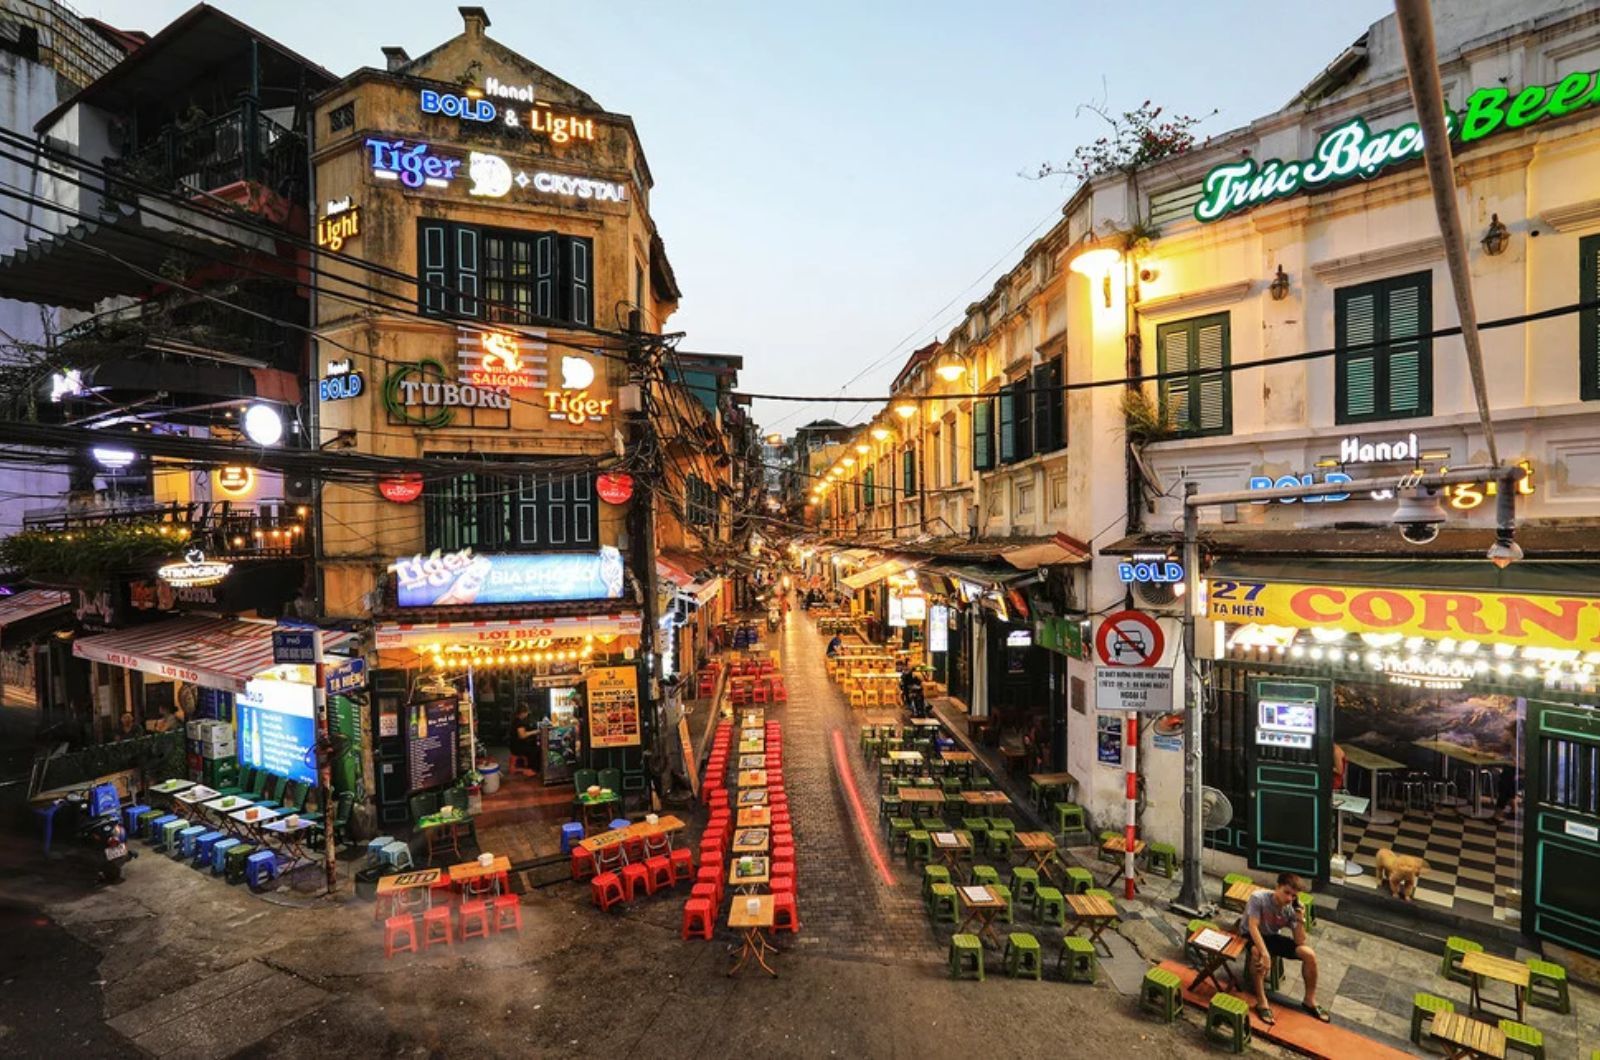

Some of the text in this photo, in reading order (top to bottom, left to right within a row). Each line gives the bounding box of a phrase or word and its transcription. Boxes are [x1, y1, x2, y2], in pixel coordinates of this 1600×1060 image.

[420, 89, 595, 144] BOLD & Light
[365, 137, 461, 188] Tiger
[1197, 159, 1299, 220] Trúc
[318, 210, 359, 251] Light
[319, 374, 362, 402] BOLD
[401, 380, 512, 410] TUBORG
[472, 372, 529, 387] SAIGON
[544, 389, 614, 425] Tiger
[1118, 562, 1184, 583] BOLD
[1212, 580, 1267, 601] 27
[1212, 602, 1266, 618] TẠ HIỆN
[1289, 585, 1600, 643] CORN
